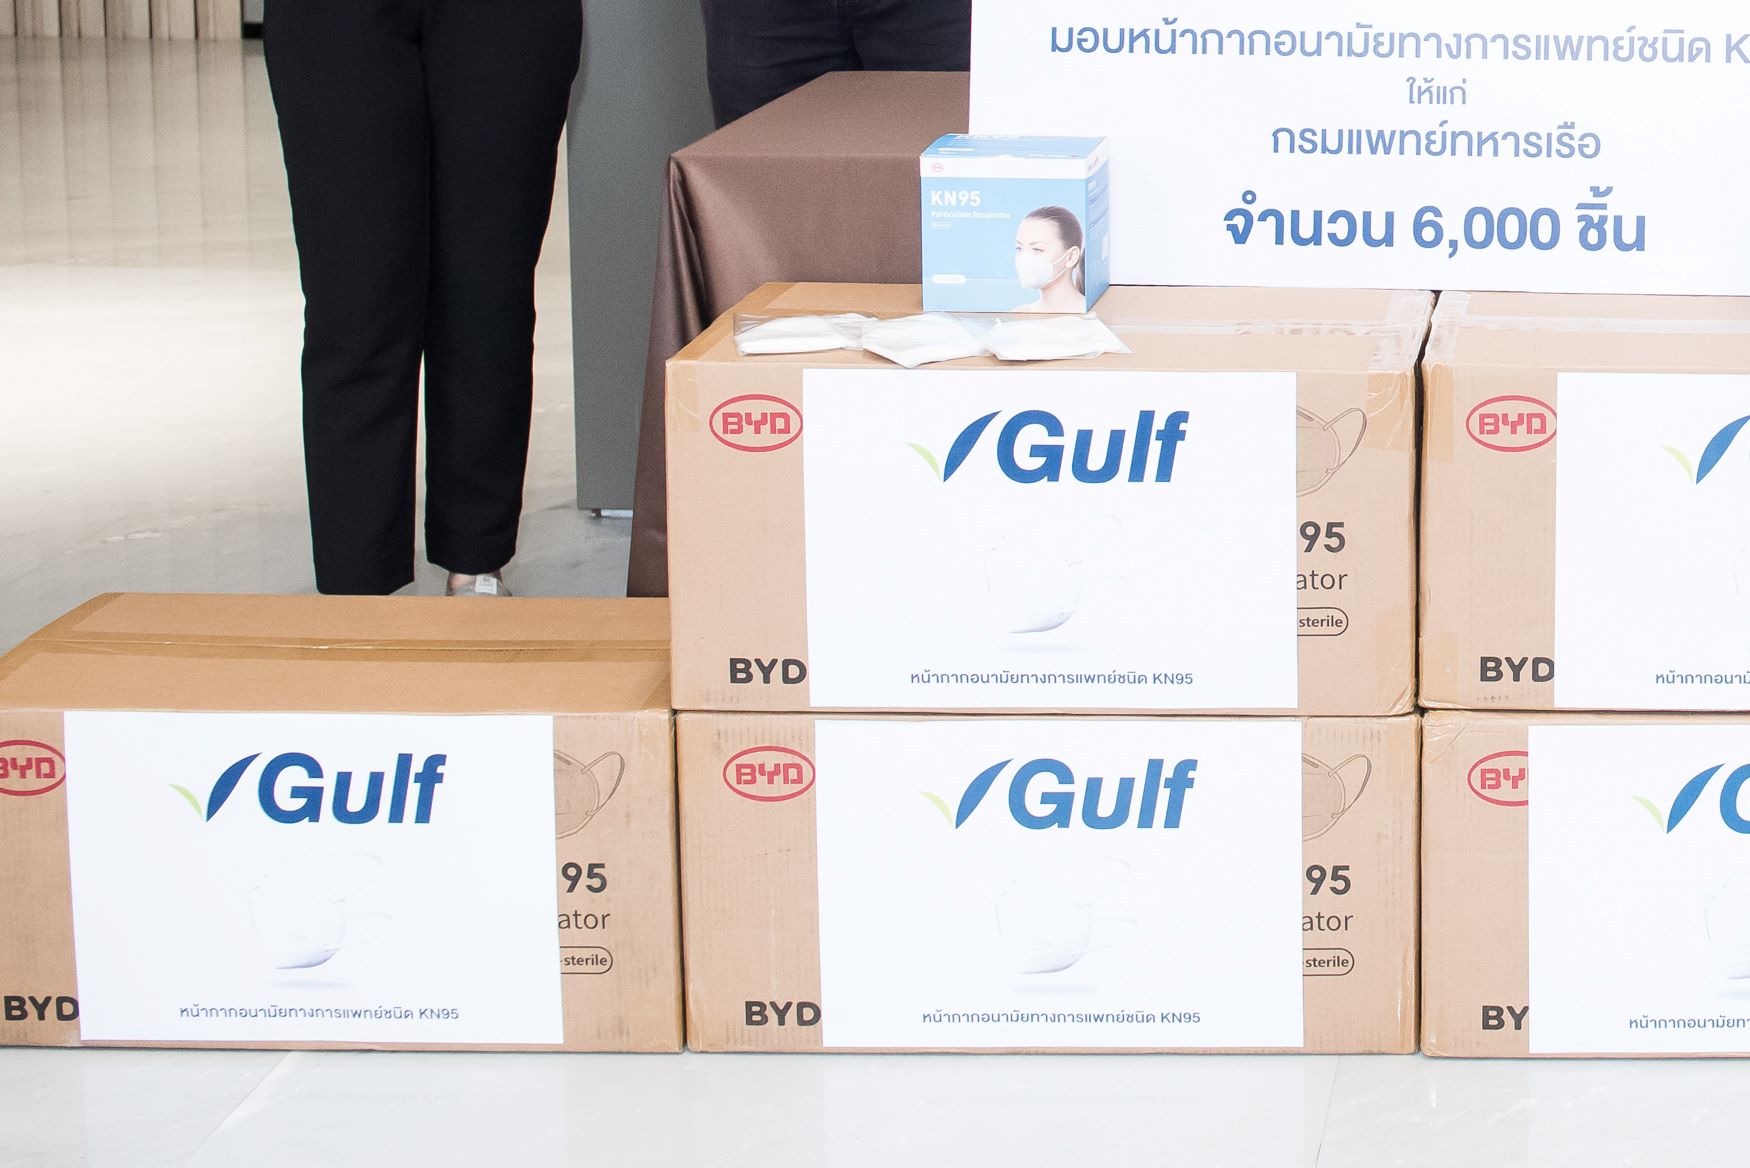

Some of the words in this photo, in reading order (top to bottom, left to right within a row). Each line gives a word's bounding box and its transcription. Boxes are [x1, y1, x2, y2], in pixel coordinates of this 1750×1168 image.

[1051, 17, 1712, 63] มอบหน้ากากอนามัยทางการแพทย์ชนิด
[1406, 76, 1467, 105] ให้แก่
[1272, 119, 1602, 160] กรมแพทย์ทหารเรือ
[931, 190, 981, 207] KN95
[1223, 190, 1395, 249] จำนวน
[1413, 205, 1561, 260] 6,000
[1575, 185, 1646, 252] ชิ้น
[722, 411, 791, 435] BYD
[1478, 412, 1548, 435] BYD
[996, 409, 1190, 485] Gulf
[1300, 521, 1345, 553] 95
[730, 658, 807, 684] BYD
[911, 669, 1148, 685] หน้ากากอนามัยทางการแพทย์ชนิด
[1153, 672, 1194, 685] KN95
[1480, 656, 1555, 683] BYD
[735, 762, 804, 786] BYD
[1481, 767, 1529, 790] BY
[257, 752, 448, 825] Gulf
[1007, 758, 1199, 831] Gulf
[561, 861, 608, 894] 95
[1306, 864, 1351, 895] 95
[1302, 956, 1350, 968] sterile
[4, 995, 80, 1021] BYD
[180, 1004, 414, 1020] หน้ากากอนามัยทางการแพทย์ชนิด
[418, 1008, 460, 1020] KN95
[745, 1001, 822, 1026] BYD
[923, 1010, 1156, 1024] หน้ากากอนามัยทางการแพทย์ชนิด
[1161, 1011, 1201, 1024] KN95
